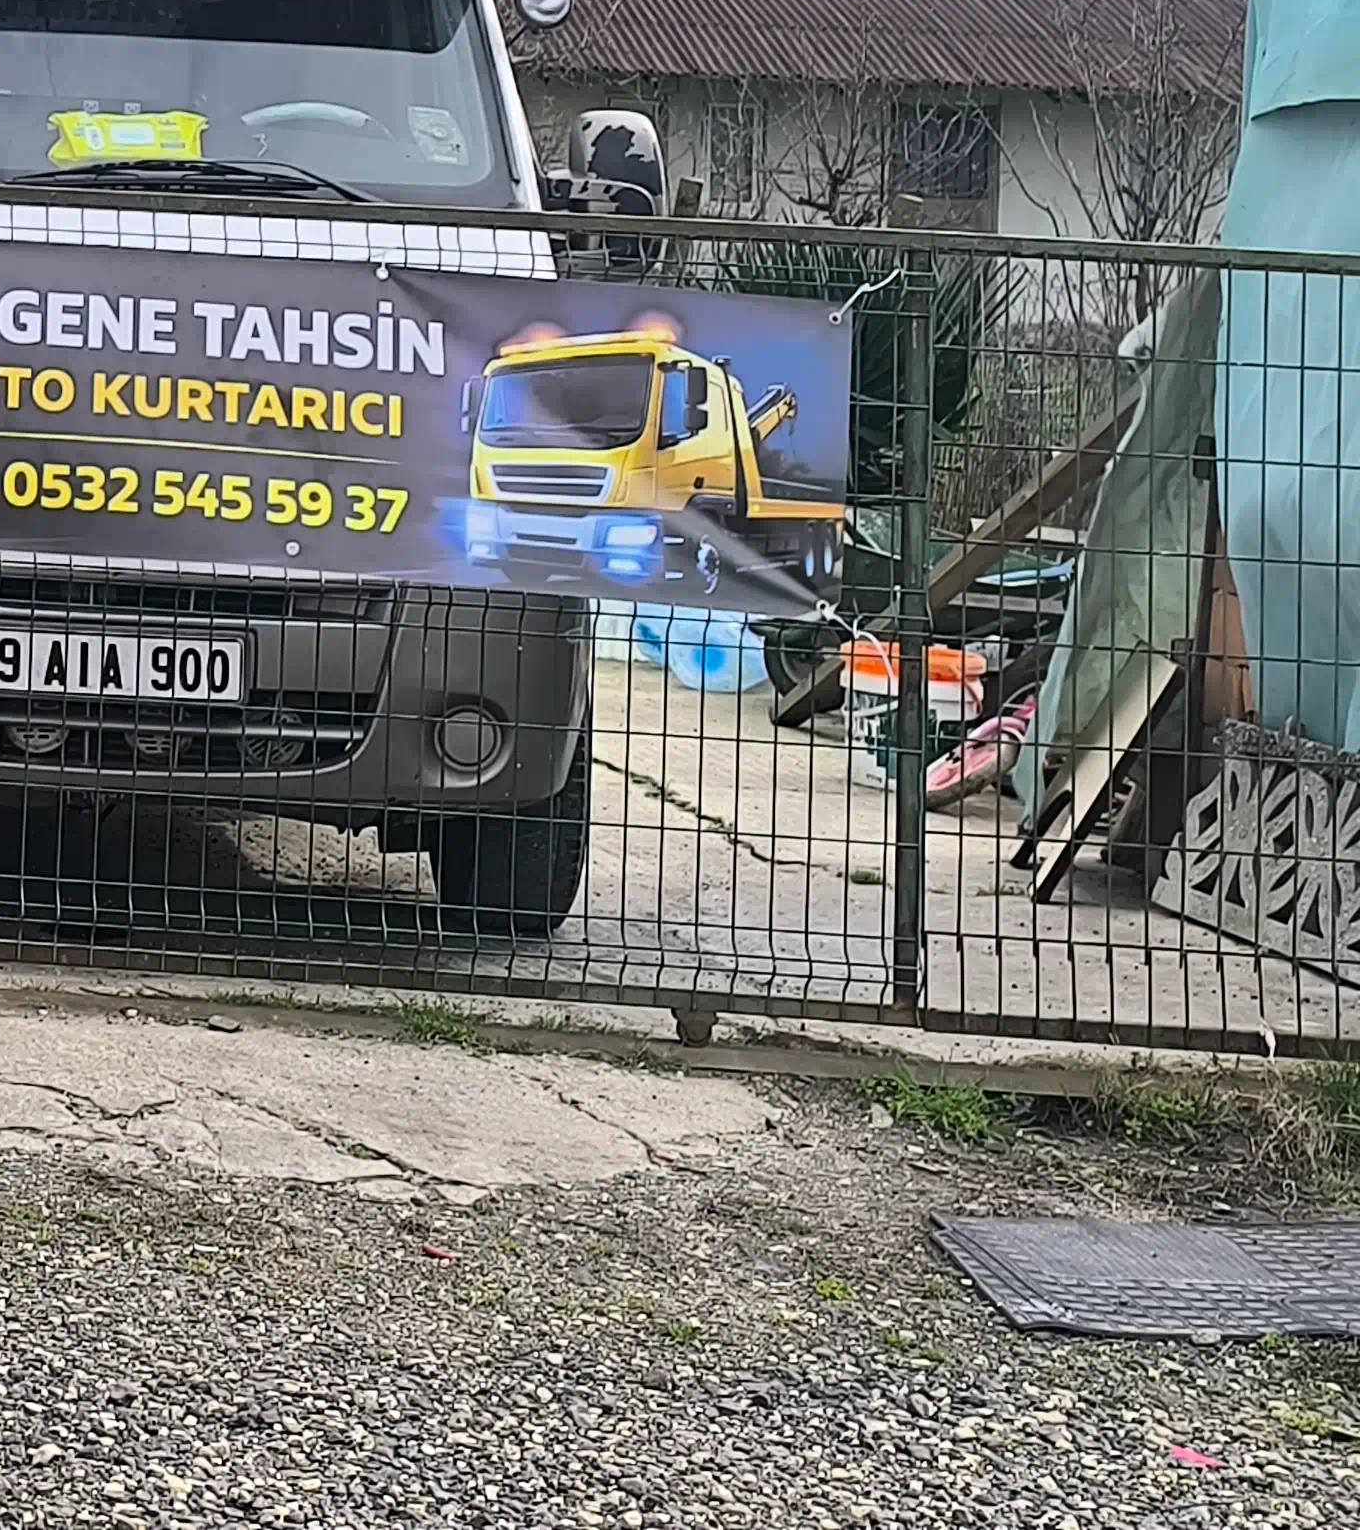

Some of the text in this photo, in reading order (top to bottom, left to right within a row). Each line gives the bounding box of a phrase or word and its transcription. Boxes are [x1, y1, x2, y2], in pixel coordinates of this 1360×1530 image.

[193, 300, 446, 376] TAHSİN
[92, 371, 402, 437] KURTARICI
[3, 461, 409, 533] 0532 545 59 37
[44, 640, 123, 690] AIA
[151, 646, 230, 694] 900
